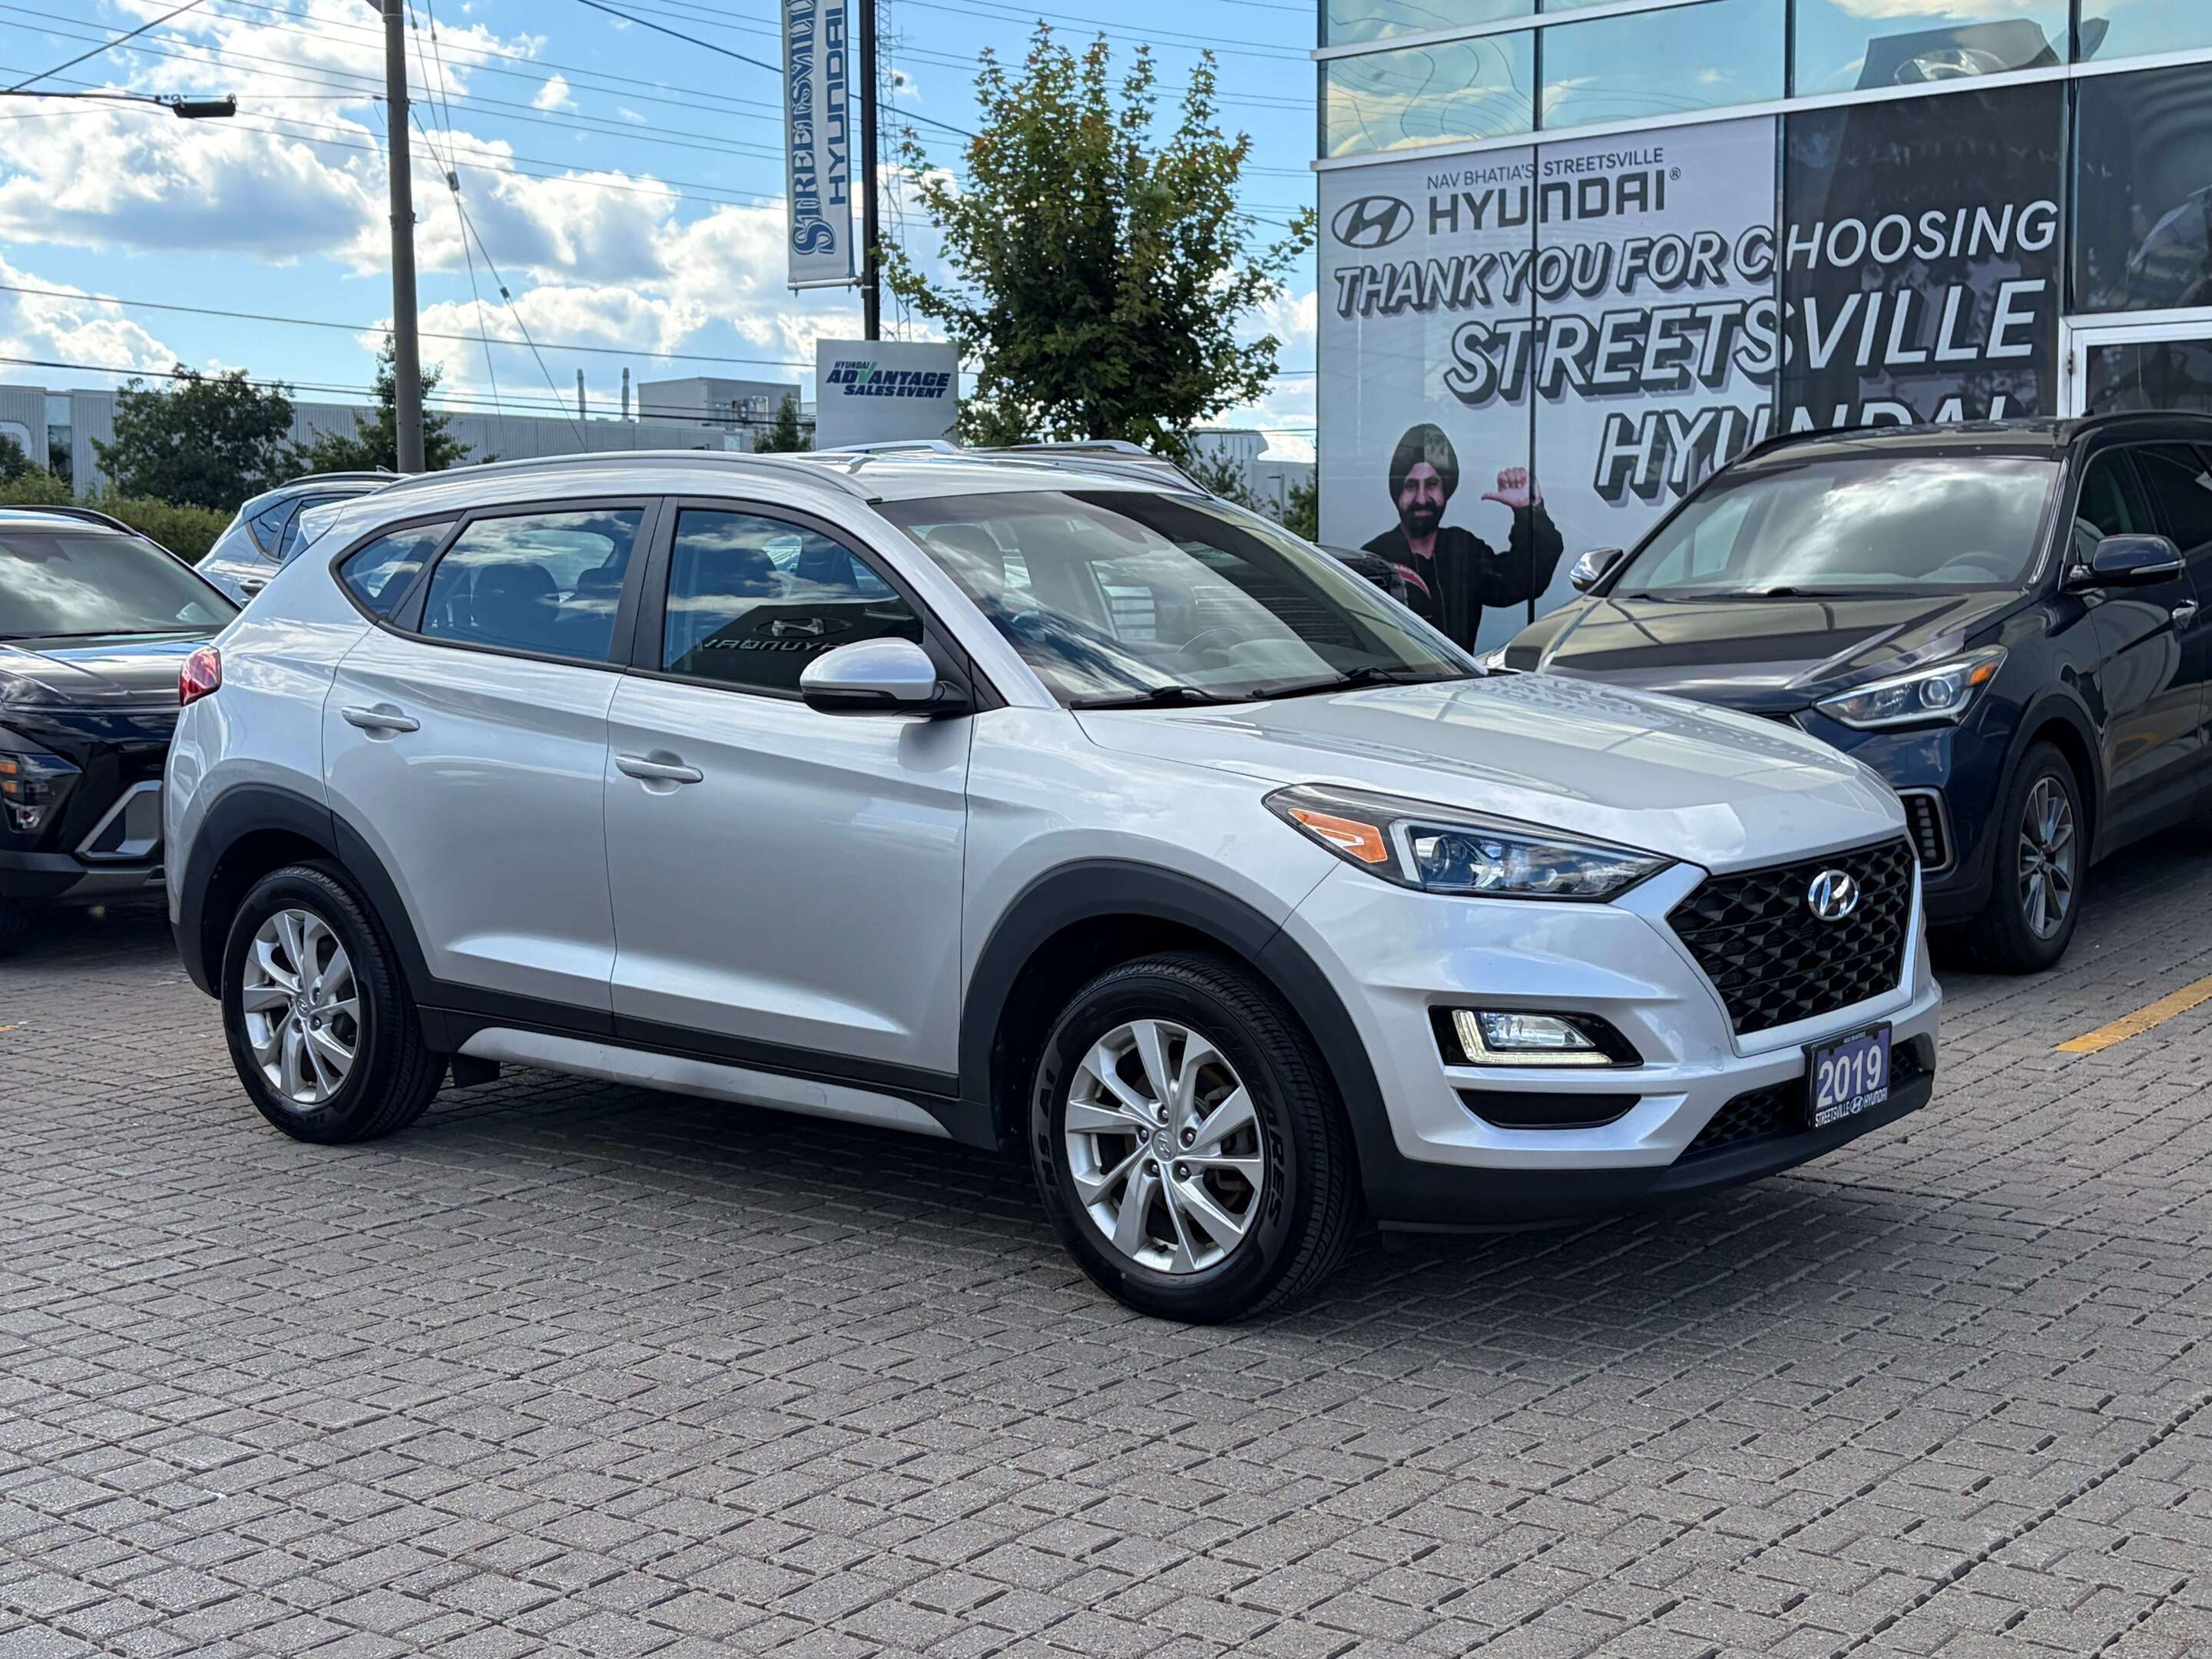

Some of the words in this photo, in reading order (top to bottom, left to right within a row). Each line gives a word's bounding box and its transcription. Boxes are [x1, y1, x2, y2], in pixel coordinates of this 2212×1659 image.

[788, 0, 836, 254] STREETSVILL
[826, 8, 846, 205] HYUNDAI
[1427, 172, 1460, 190] NAV
[1464, 164, 1535, 186] BHATIA'S
[1543, 147, 1664, 176] STREETSVILLE
[1617, 231, 1727, 294] FOR
[1735, 200, 2059, 281] CHOOSING
[834, 361, 870, 369] HYUNDAI
[1444, 279, 2048, 408] STREETSVILLE
[826, 362, 950, 386] ADVANTAGE
[843, 385, 896, 396] SALES
[896, 386, 946, 398] EVENT
[1816, 1045, 1881, 1108] 2019
[1815, 1102, 1849, 1127] STREETSVILLE
[1864, 1088, 1887, 1108] HYUNDAI
